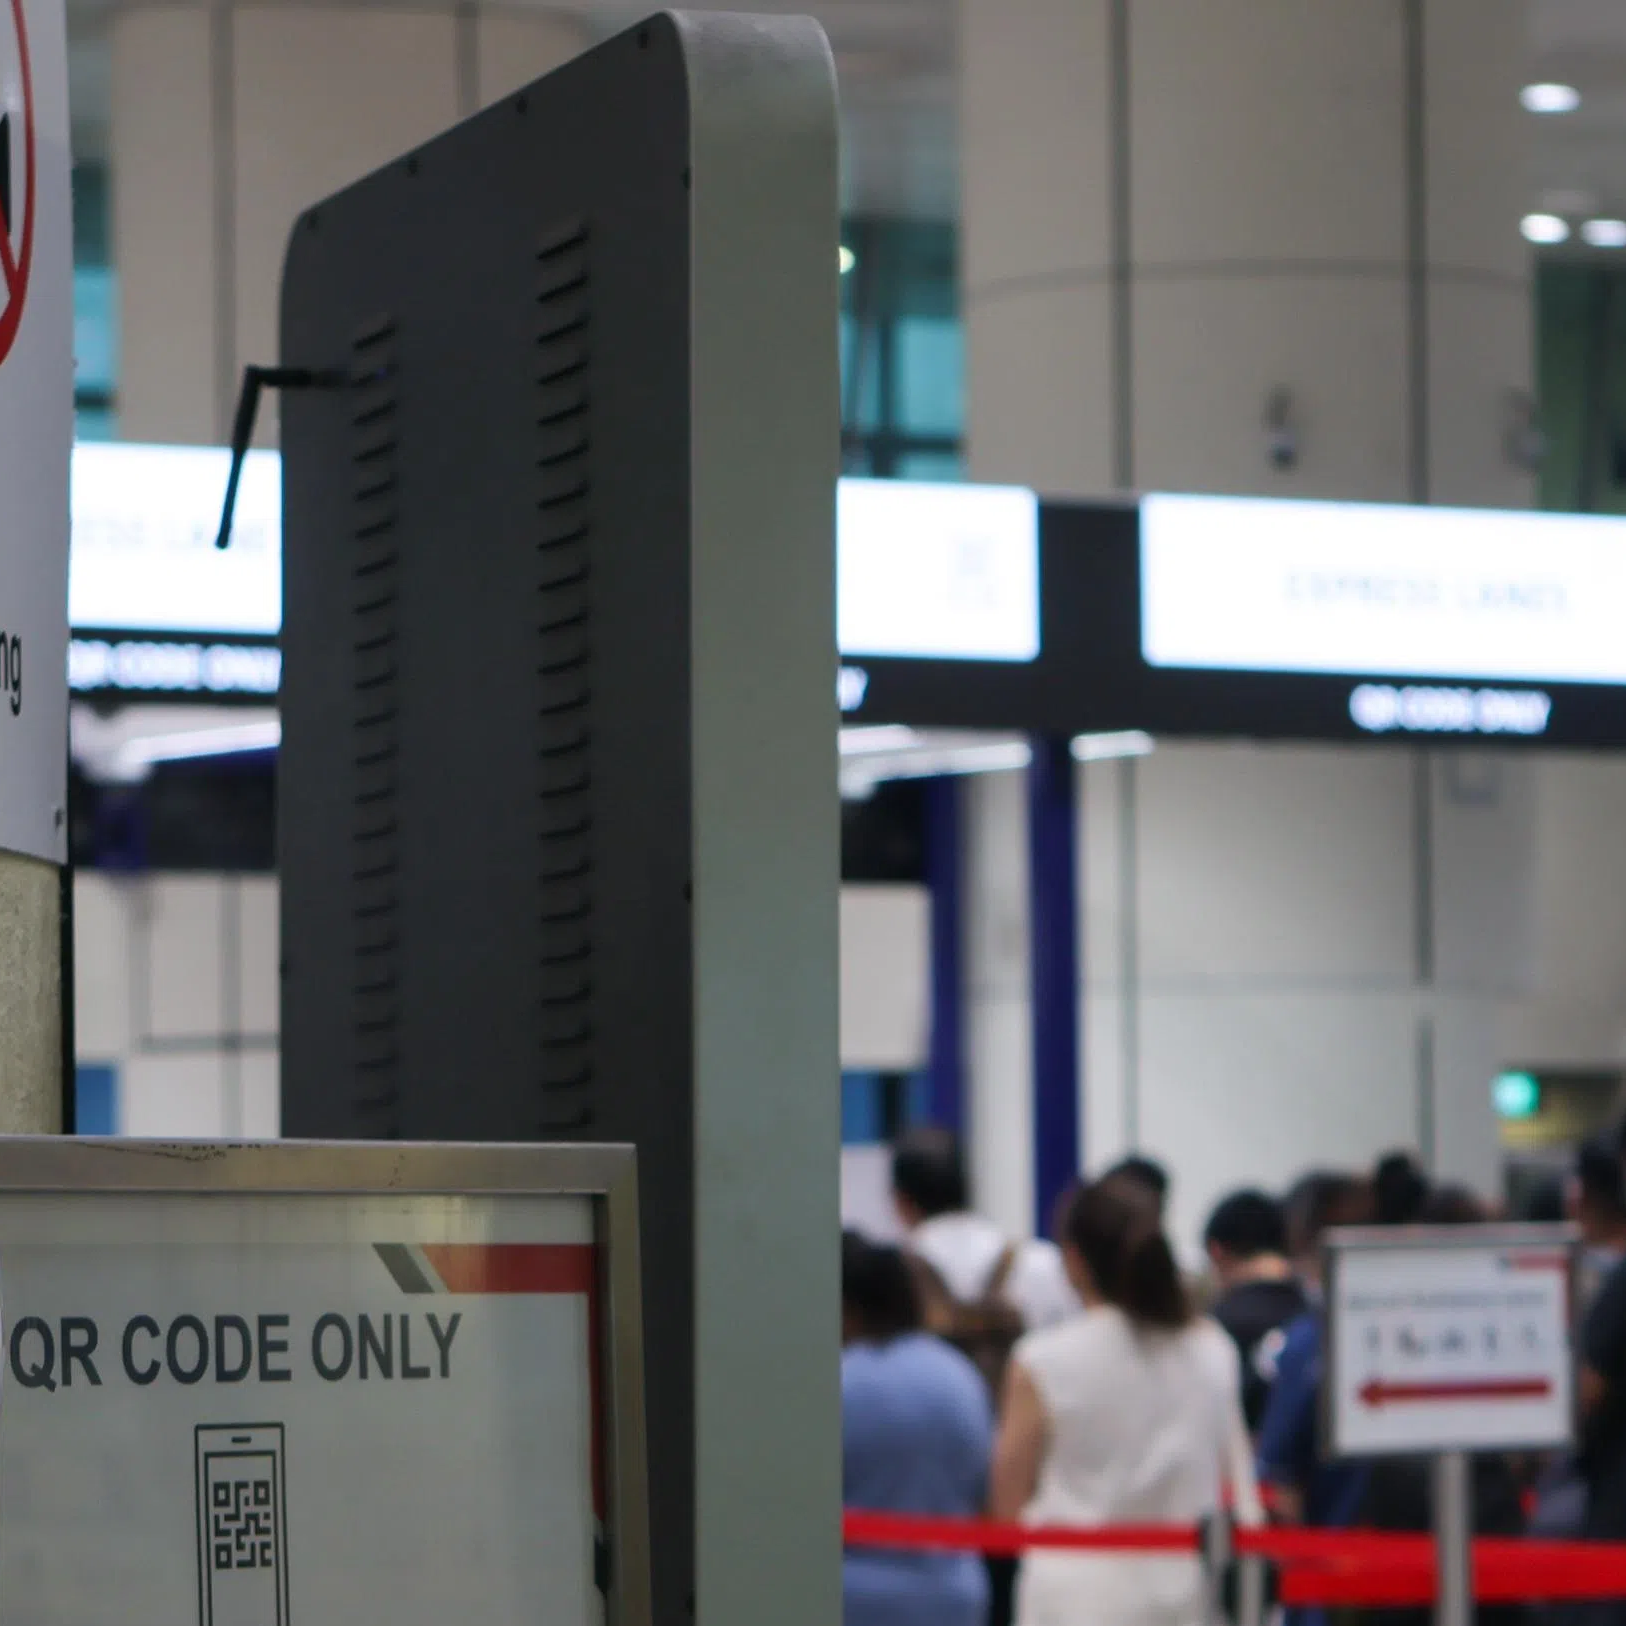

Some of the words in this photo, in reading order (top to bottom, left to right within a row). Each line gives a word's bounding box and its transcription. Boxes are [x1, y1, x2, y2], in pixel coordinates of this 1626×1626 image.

[8, 1314, 105, 1394] QR
[120, 1312, 293, 1387] CODE
[310, 1311, 463, 1384] ONLY
